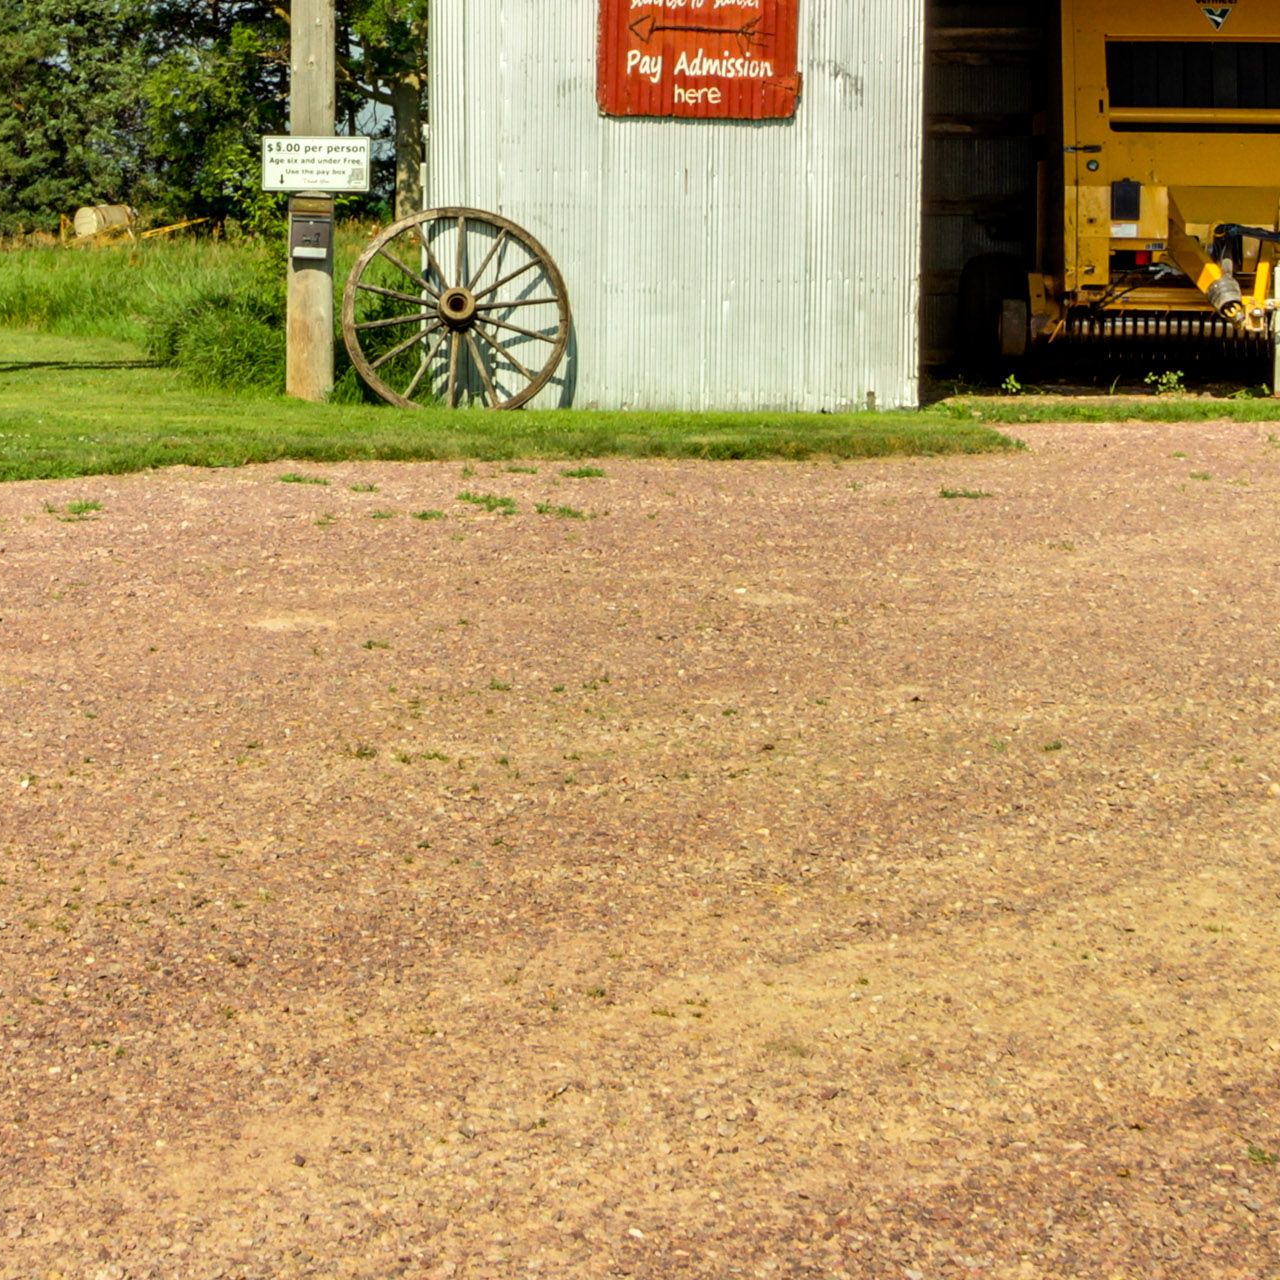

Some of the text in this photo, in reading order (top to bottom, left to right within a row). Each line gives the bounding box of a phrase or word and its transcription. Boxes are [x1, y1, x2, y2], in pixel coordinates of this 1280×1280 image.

[626, 48, 774, 84] Pay Admission
[674, 84, 721, 106] here
[304, 145, 322, 154] per
[327, 145, 366, 154] person
[269, 157, 284, 165] Age
